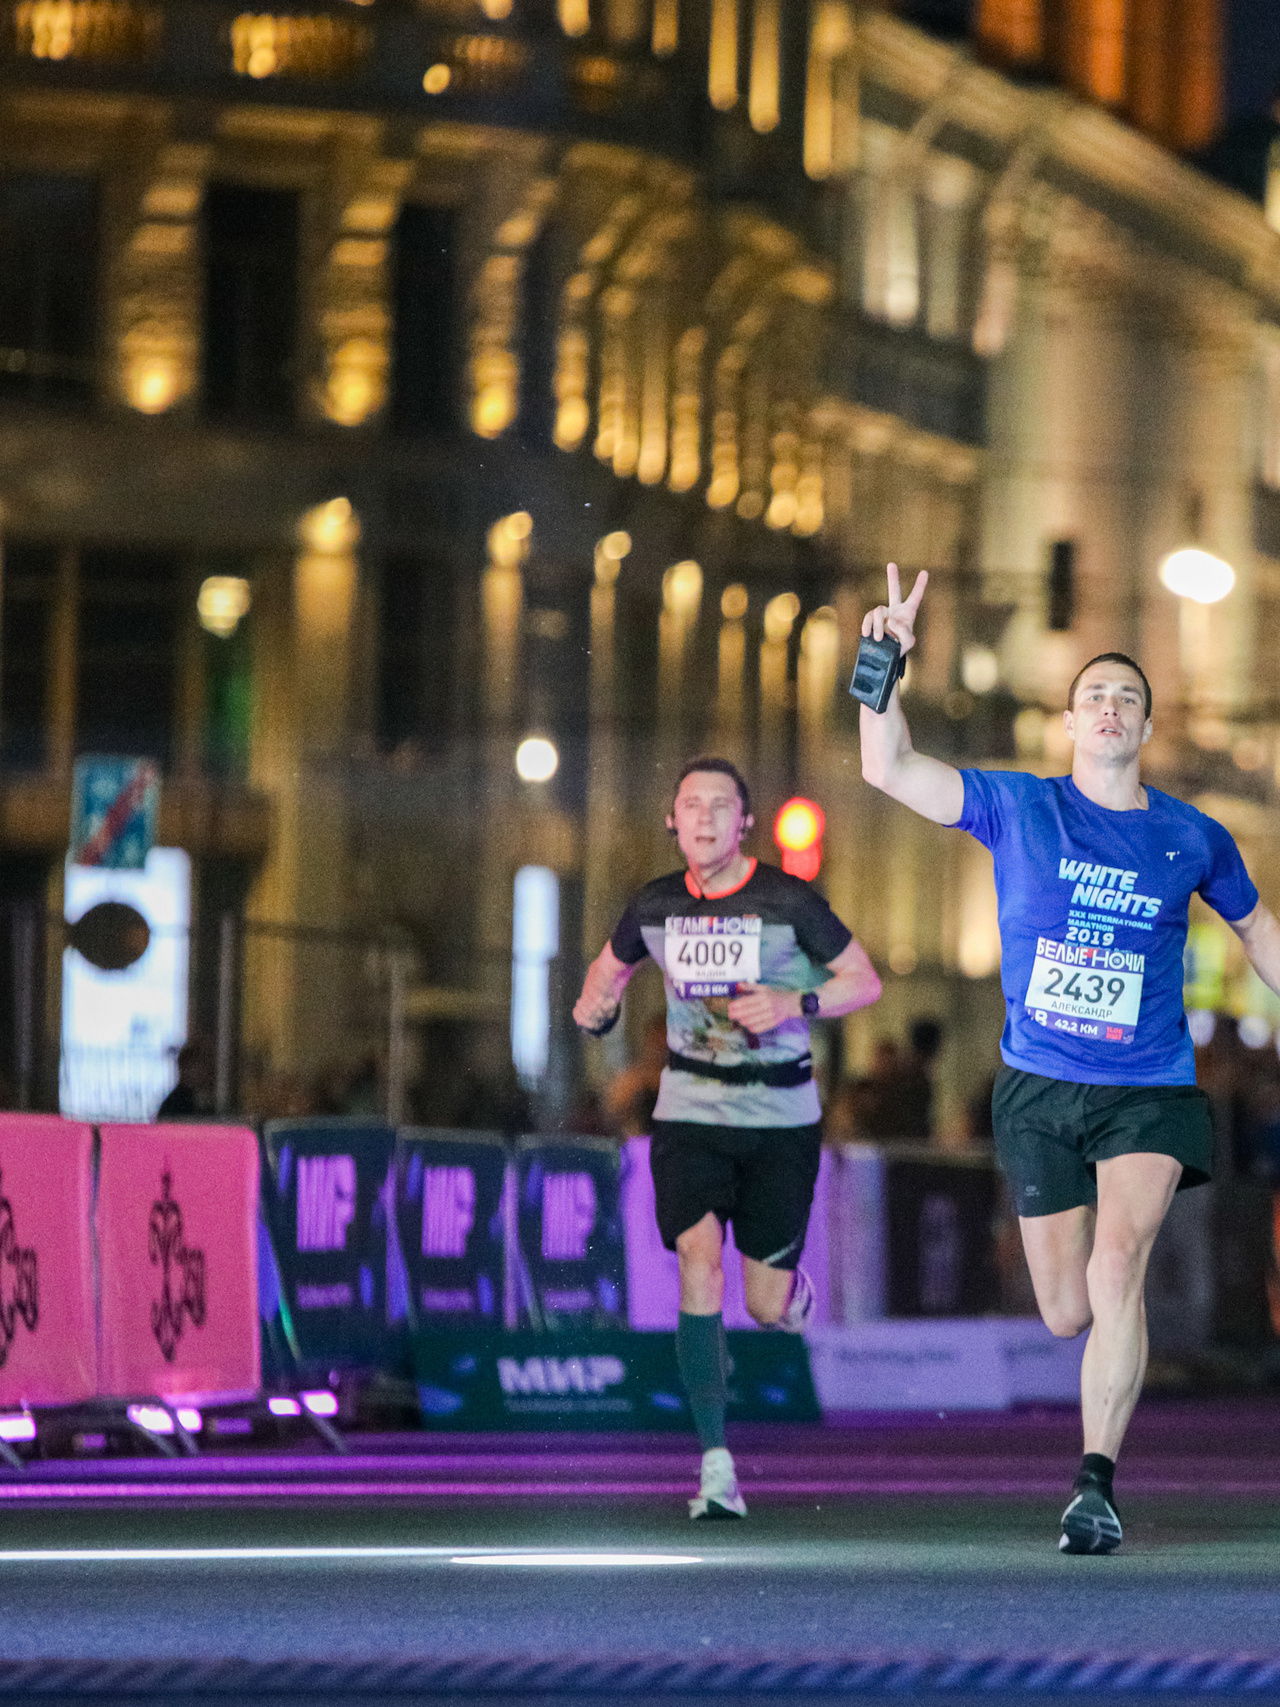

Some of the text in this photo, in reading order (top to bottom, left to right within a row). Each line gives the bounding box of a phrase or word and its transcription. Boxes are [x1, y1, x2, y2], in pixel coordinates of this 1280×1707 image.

[1058, 857, 1139, 892] WHITE
[1070, 882, 1163, 918] NIGHTS
[1067, 918, 1114, 932] MARATHON
[1068, 909, 1153, 931] XXX INTERNATIONAL
[1065, 926, 1115, 946] 2019
[678, 940, 743, 966] 4009
[1036, 937, 1089, 966] БЕЛЫЕ
[1091, 949, 1145, 973] НОЧИ
[1043, 967, 1125, 1006] 2439
[1051, 1000, 1113, 1019] АЛЕКСАНДР
[1054, 1019, 1078, 1032] 42,2
[497, 1354, 625, 1394] МИР
